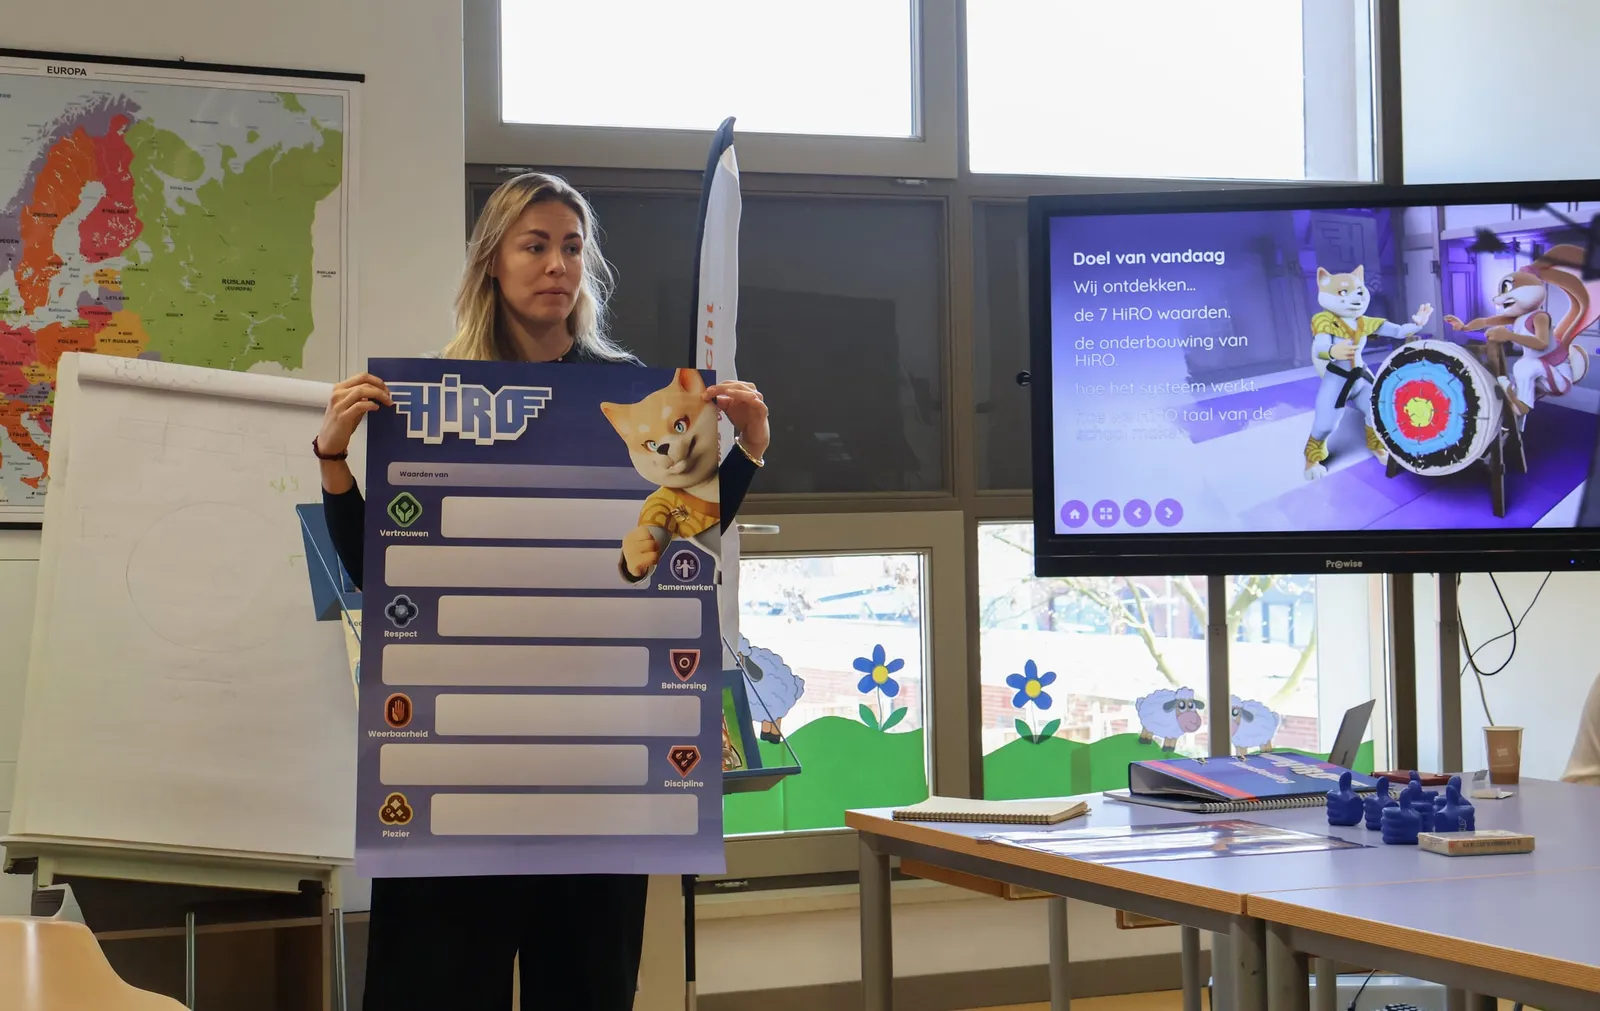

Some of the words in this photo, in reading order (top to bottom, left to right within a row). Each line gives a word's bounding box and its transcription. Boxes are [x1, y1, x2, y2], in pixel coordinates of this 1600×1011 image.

[46, 65, 87, 76] EUROPA
[1073, 251, 1111, 266] Doel
[1115, 253, 1146, 264] van
[1151, 249, 1226, 265] vandaag
[221, 278, 256, 286] RUSLAND
[1073, 280, 1098, 297] Wij
[1103, 278, 1196, 294] ontdekken...
[1074, 308, 1095, 322] de
[1099, 307, 1108, 321] 7
[1112, 306, 1153, 321] HiRO
[1157, 305, 1231, 320] waarden.
[1074, 336, 1095, 350] de
[1099, 335, 1214, 350] onderbouwing
[1218, 335, 1248, 347] van
[1075, 353, 1119, 367] HiRO.
[1076, 382, 1105, 396] hoe
[1110, 382, 1135, 395] het
[1140, 380, 1206, 396] systeem
[1211, 378, 1259, 393] werkt.
[1183, 408, 1213, 421] taal
[1218, 409, 1247, 421] van
[1252, 407, 1274, 421] de
[380, 529, 429, 537] Vertrouwen
[1325, 559, 1363, 569] Prowise
[657, 583, 714, 591] Samenwerken
[384, 630, 418, 639] Respect
[661, 682, 707, 691] Beheersing
[368, 730, 429, 738] Weerbaarheid
[664, 780, 704, 789] Discipline
[382, 830, 410, 838] Plezier
